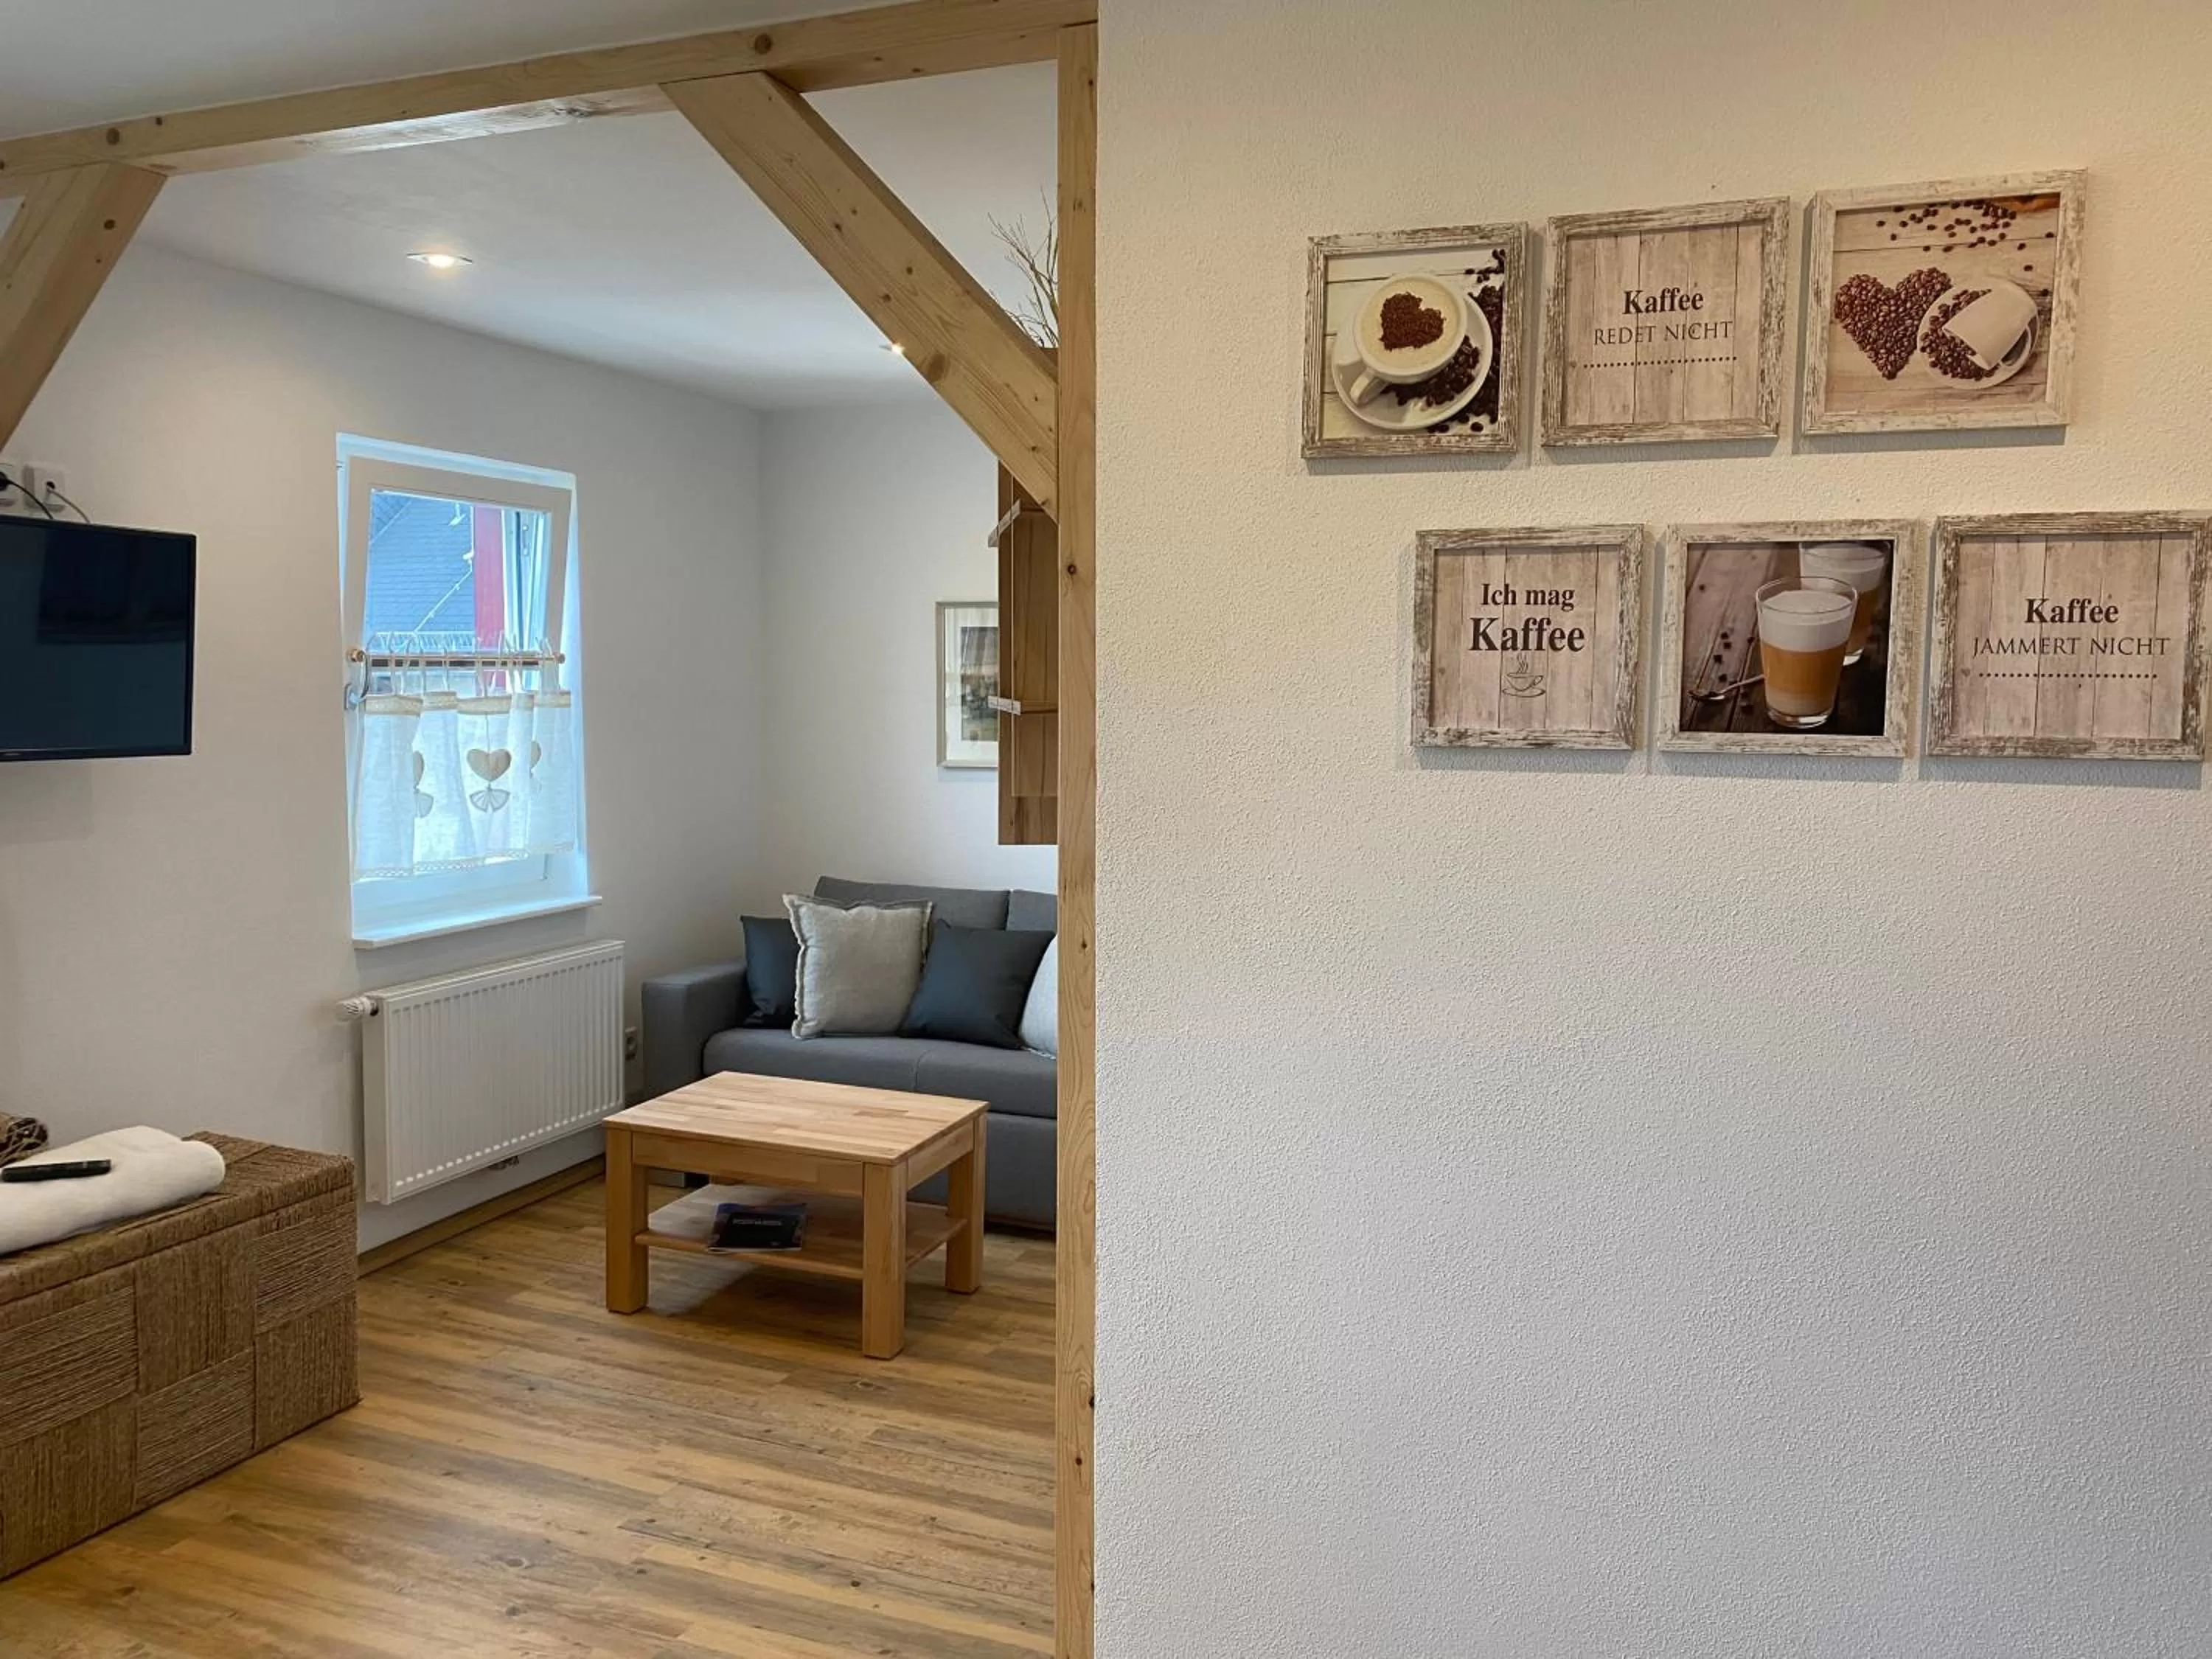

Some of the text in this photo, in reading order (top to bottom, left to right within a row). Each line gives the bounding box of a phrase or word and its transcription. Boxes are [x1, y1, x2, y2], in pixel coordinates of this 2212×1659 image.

[1622, 287, 1704, 315] Kaffee
[1594, 321, 1733, 346] REDET NICHT
[1481, 583, 1576, 612] Ich mag
[2025, 598, 2119, 624] Kaffee
[1469, 616, 1585, 652] Kaffee
[1972, 637, 2171, 658] JAMMERT NICHT
